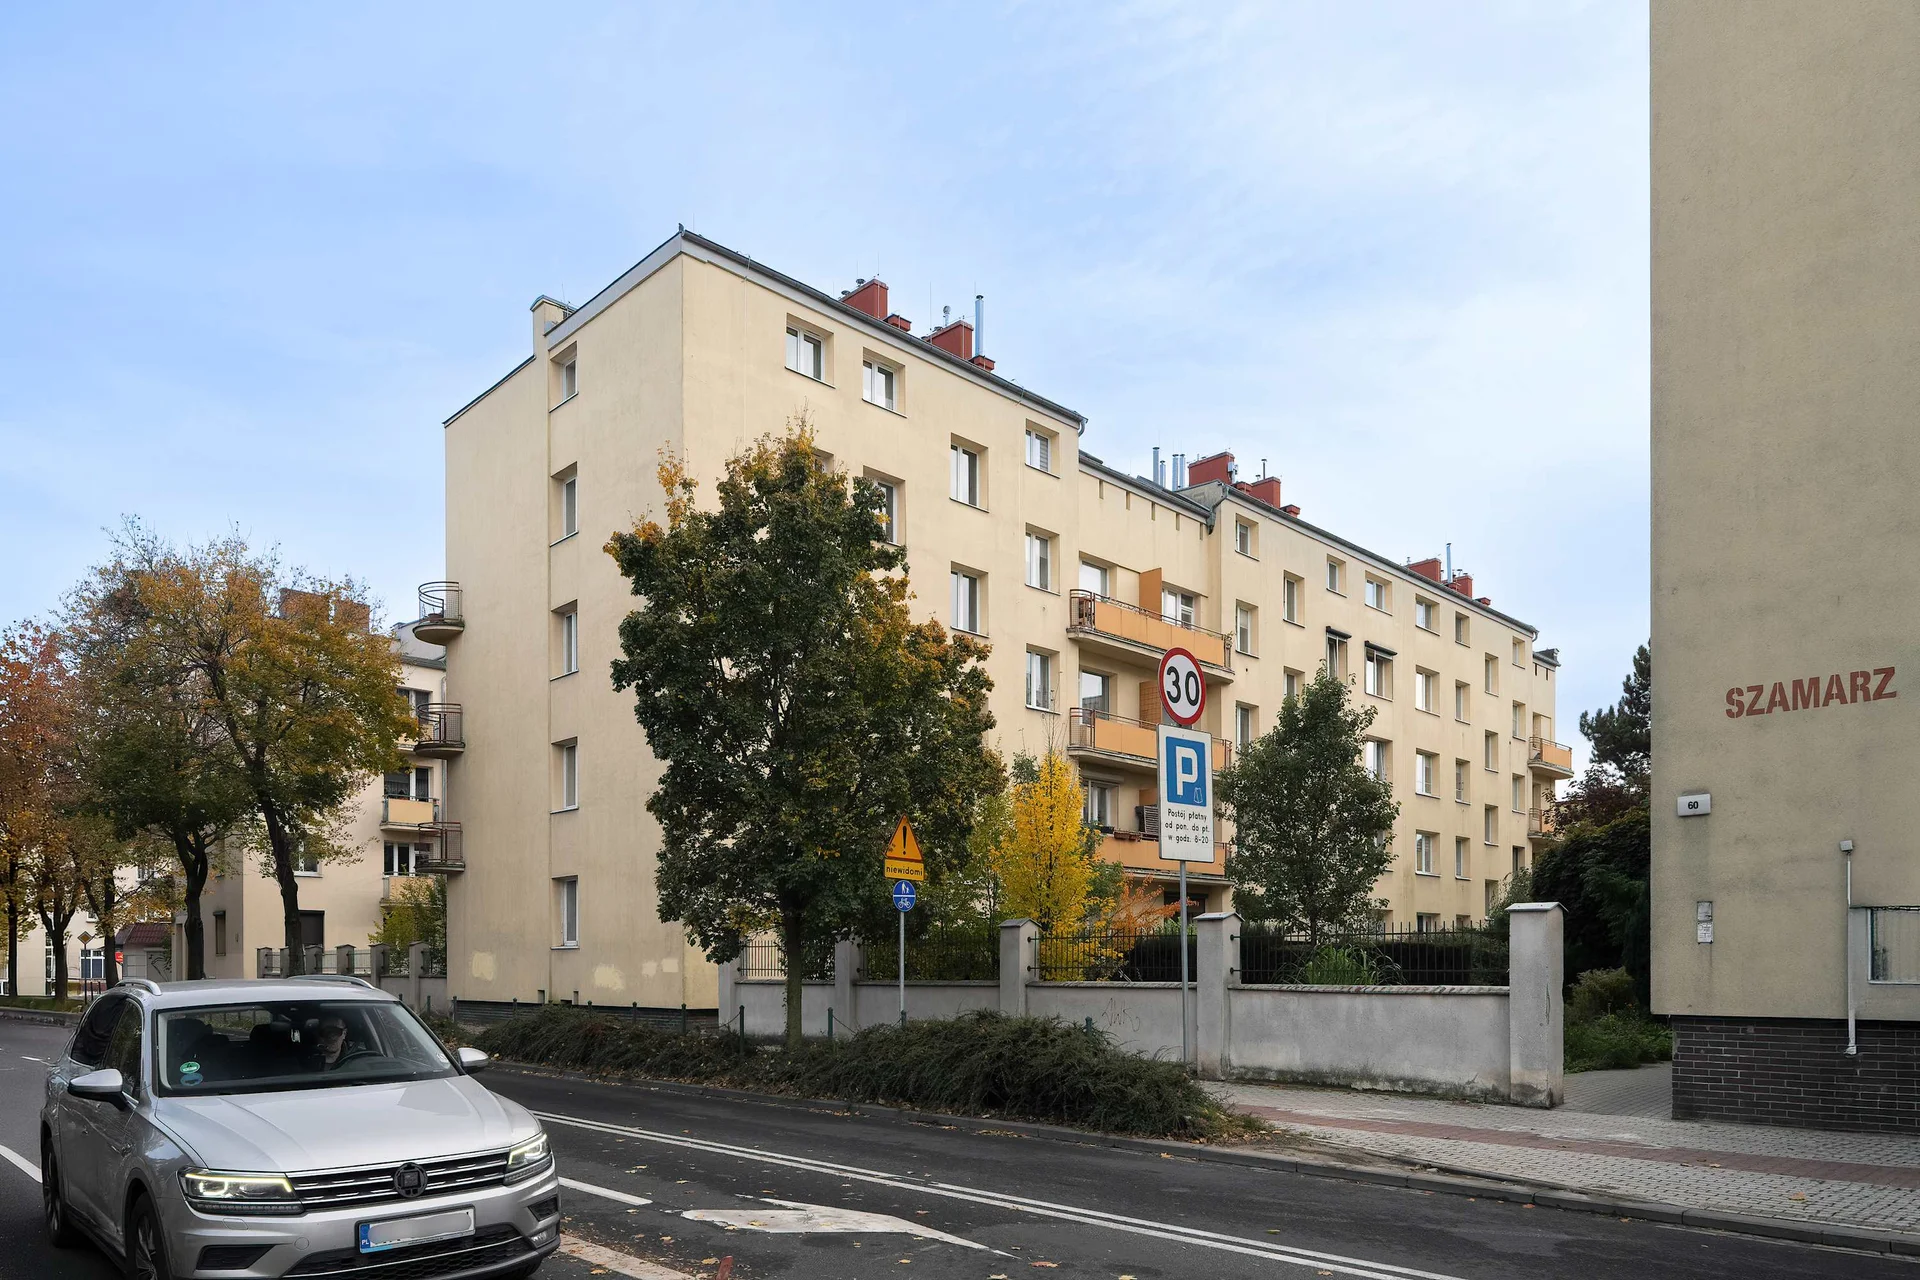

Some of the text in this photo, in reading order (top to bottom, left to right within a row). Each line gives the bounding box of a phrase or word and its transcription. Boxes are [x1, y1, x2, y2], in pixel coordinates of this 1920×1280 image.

[1166, 665, 1200, 706] 30
[1725, 666, 1897, 719] SZAMARZ
[1175, 746, 1198, 796] P
[1687, 801, 1699, 810] 60
[1167, 808, 1207, 823] Postój płatny
[1164, 821, 1210, 834] od pon. do pt.
[1175, 834, 1191, 843] godz.
[1194, 835, 1209, 844] 8-20
[886, 865, 923, 876] niewidomi
